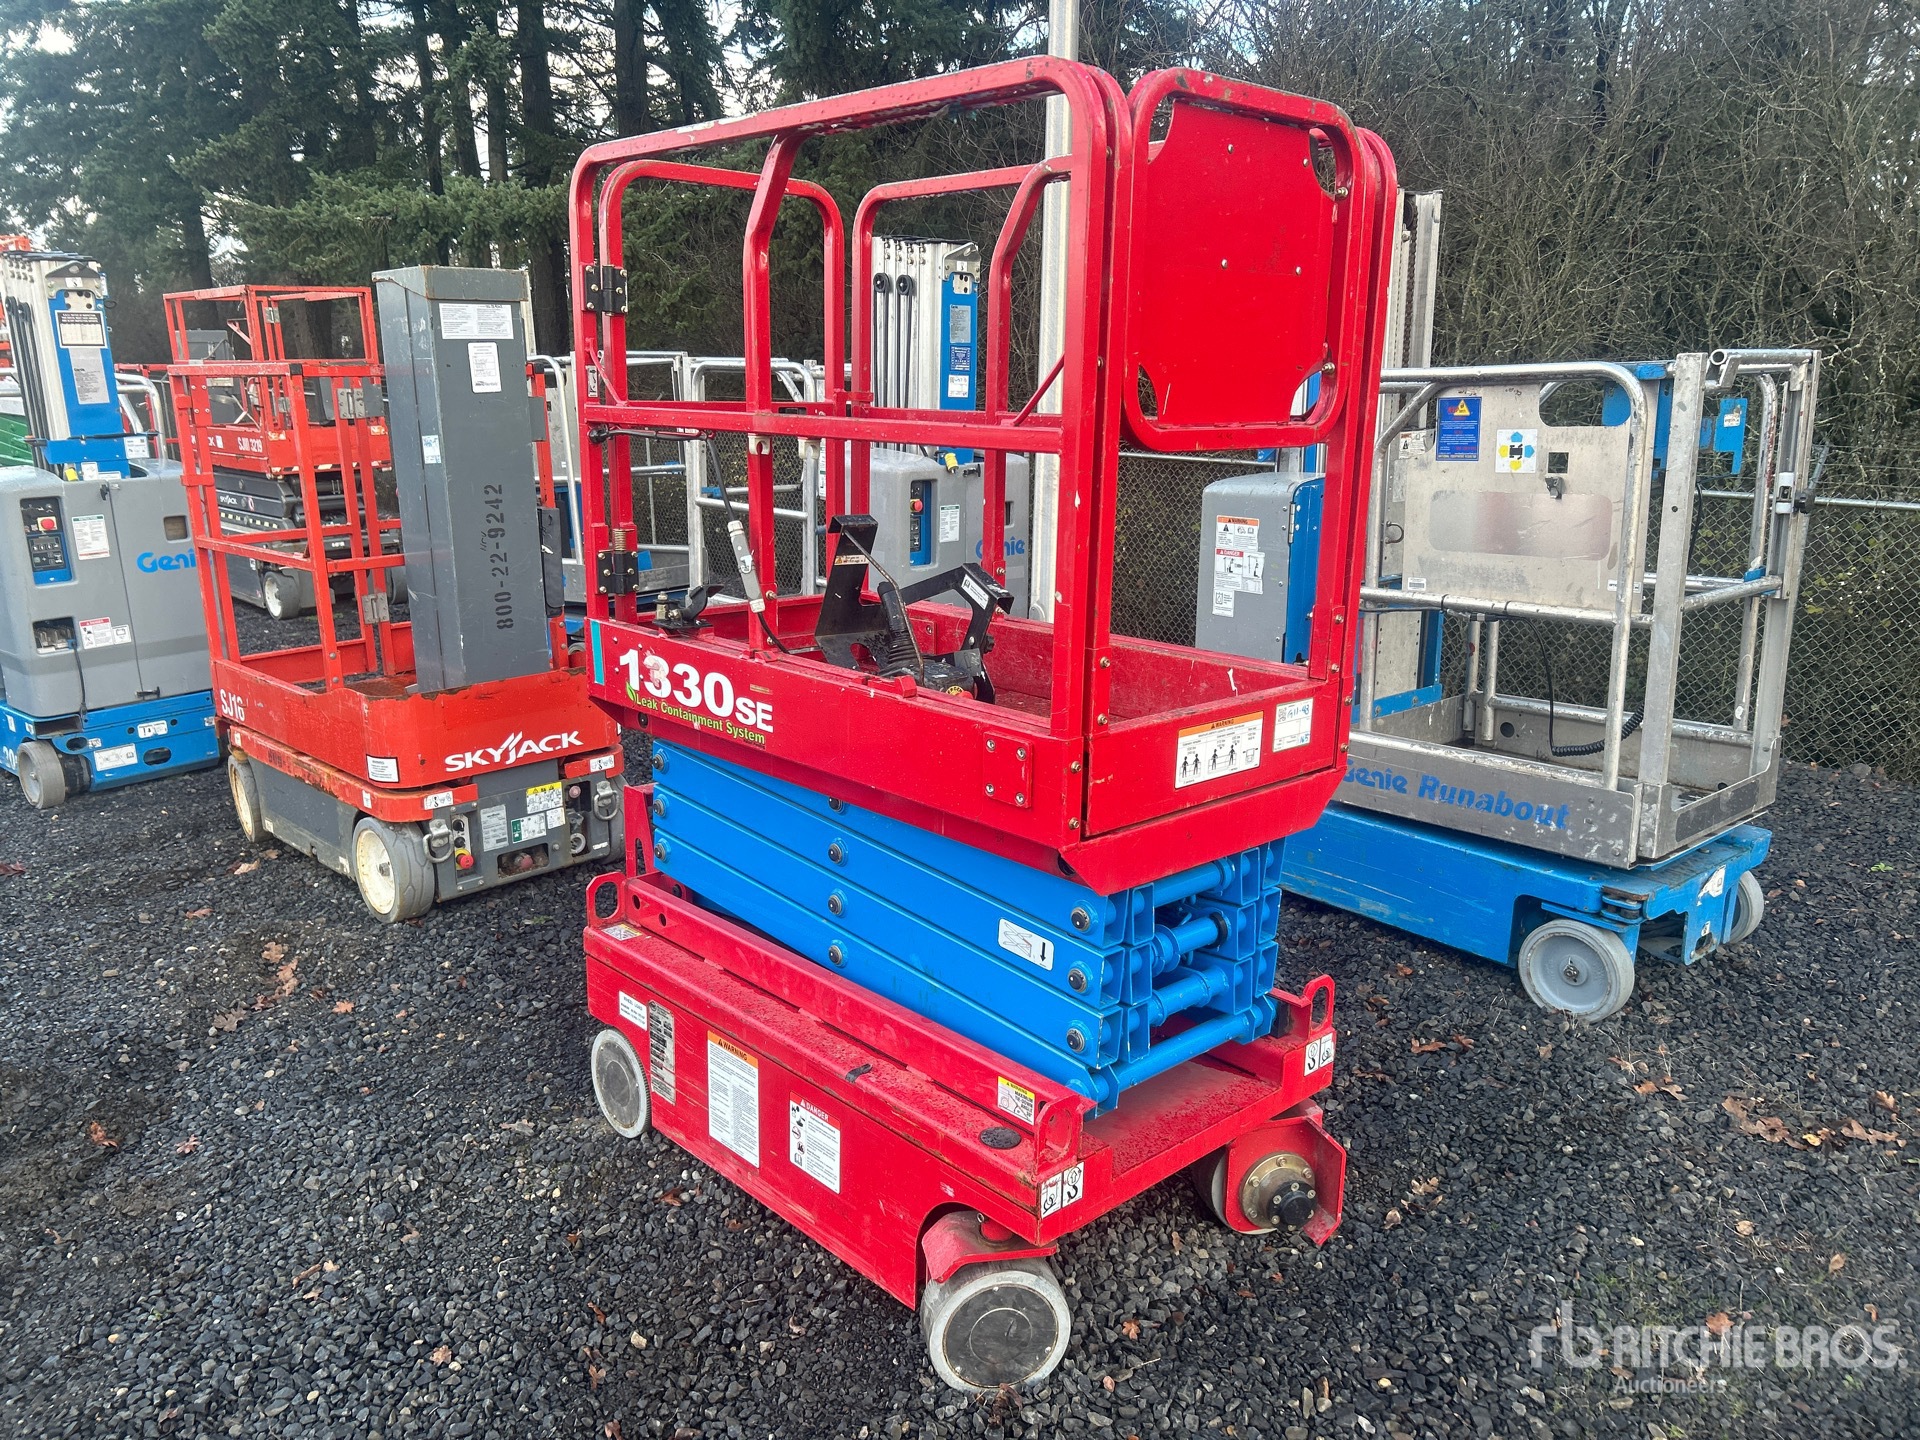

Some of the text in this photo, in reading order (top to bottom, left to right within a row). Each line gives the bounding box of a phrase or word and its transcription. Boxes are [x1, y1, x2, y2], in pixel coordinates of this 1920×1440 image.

[136, 548, 212, 573] Geni
[484, 484, 514, 630] 800-22-9242
[975, 536, 1026, 560] Gnie
[220, 689, 245, 722] SJ16
[636, 694, 766, 744] Leak Containment System
[1215, 719, 1235, 732] WARNING
[445, 731, 583, 772] SKYJACK
[1418, 774, 1570, 830] Runabout
[723, 1041, 748, 1061] WARNING
[805, 1102, 829, 1122] DANGER
